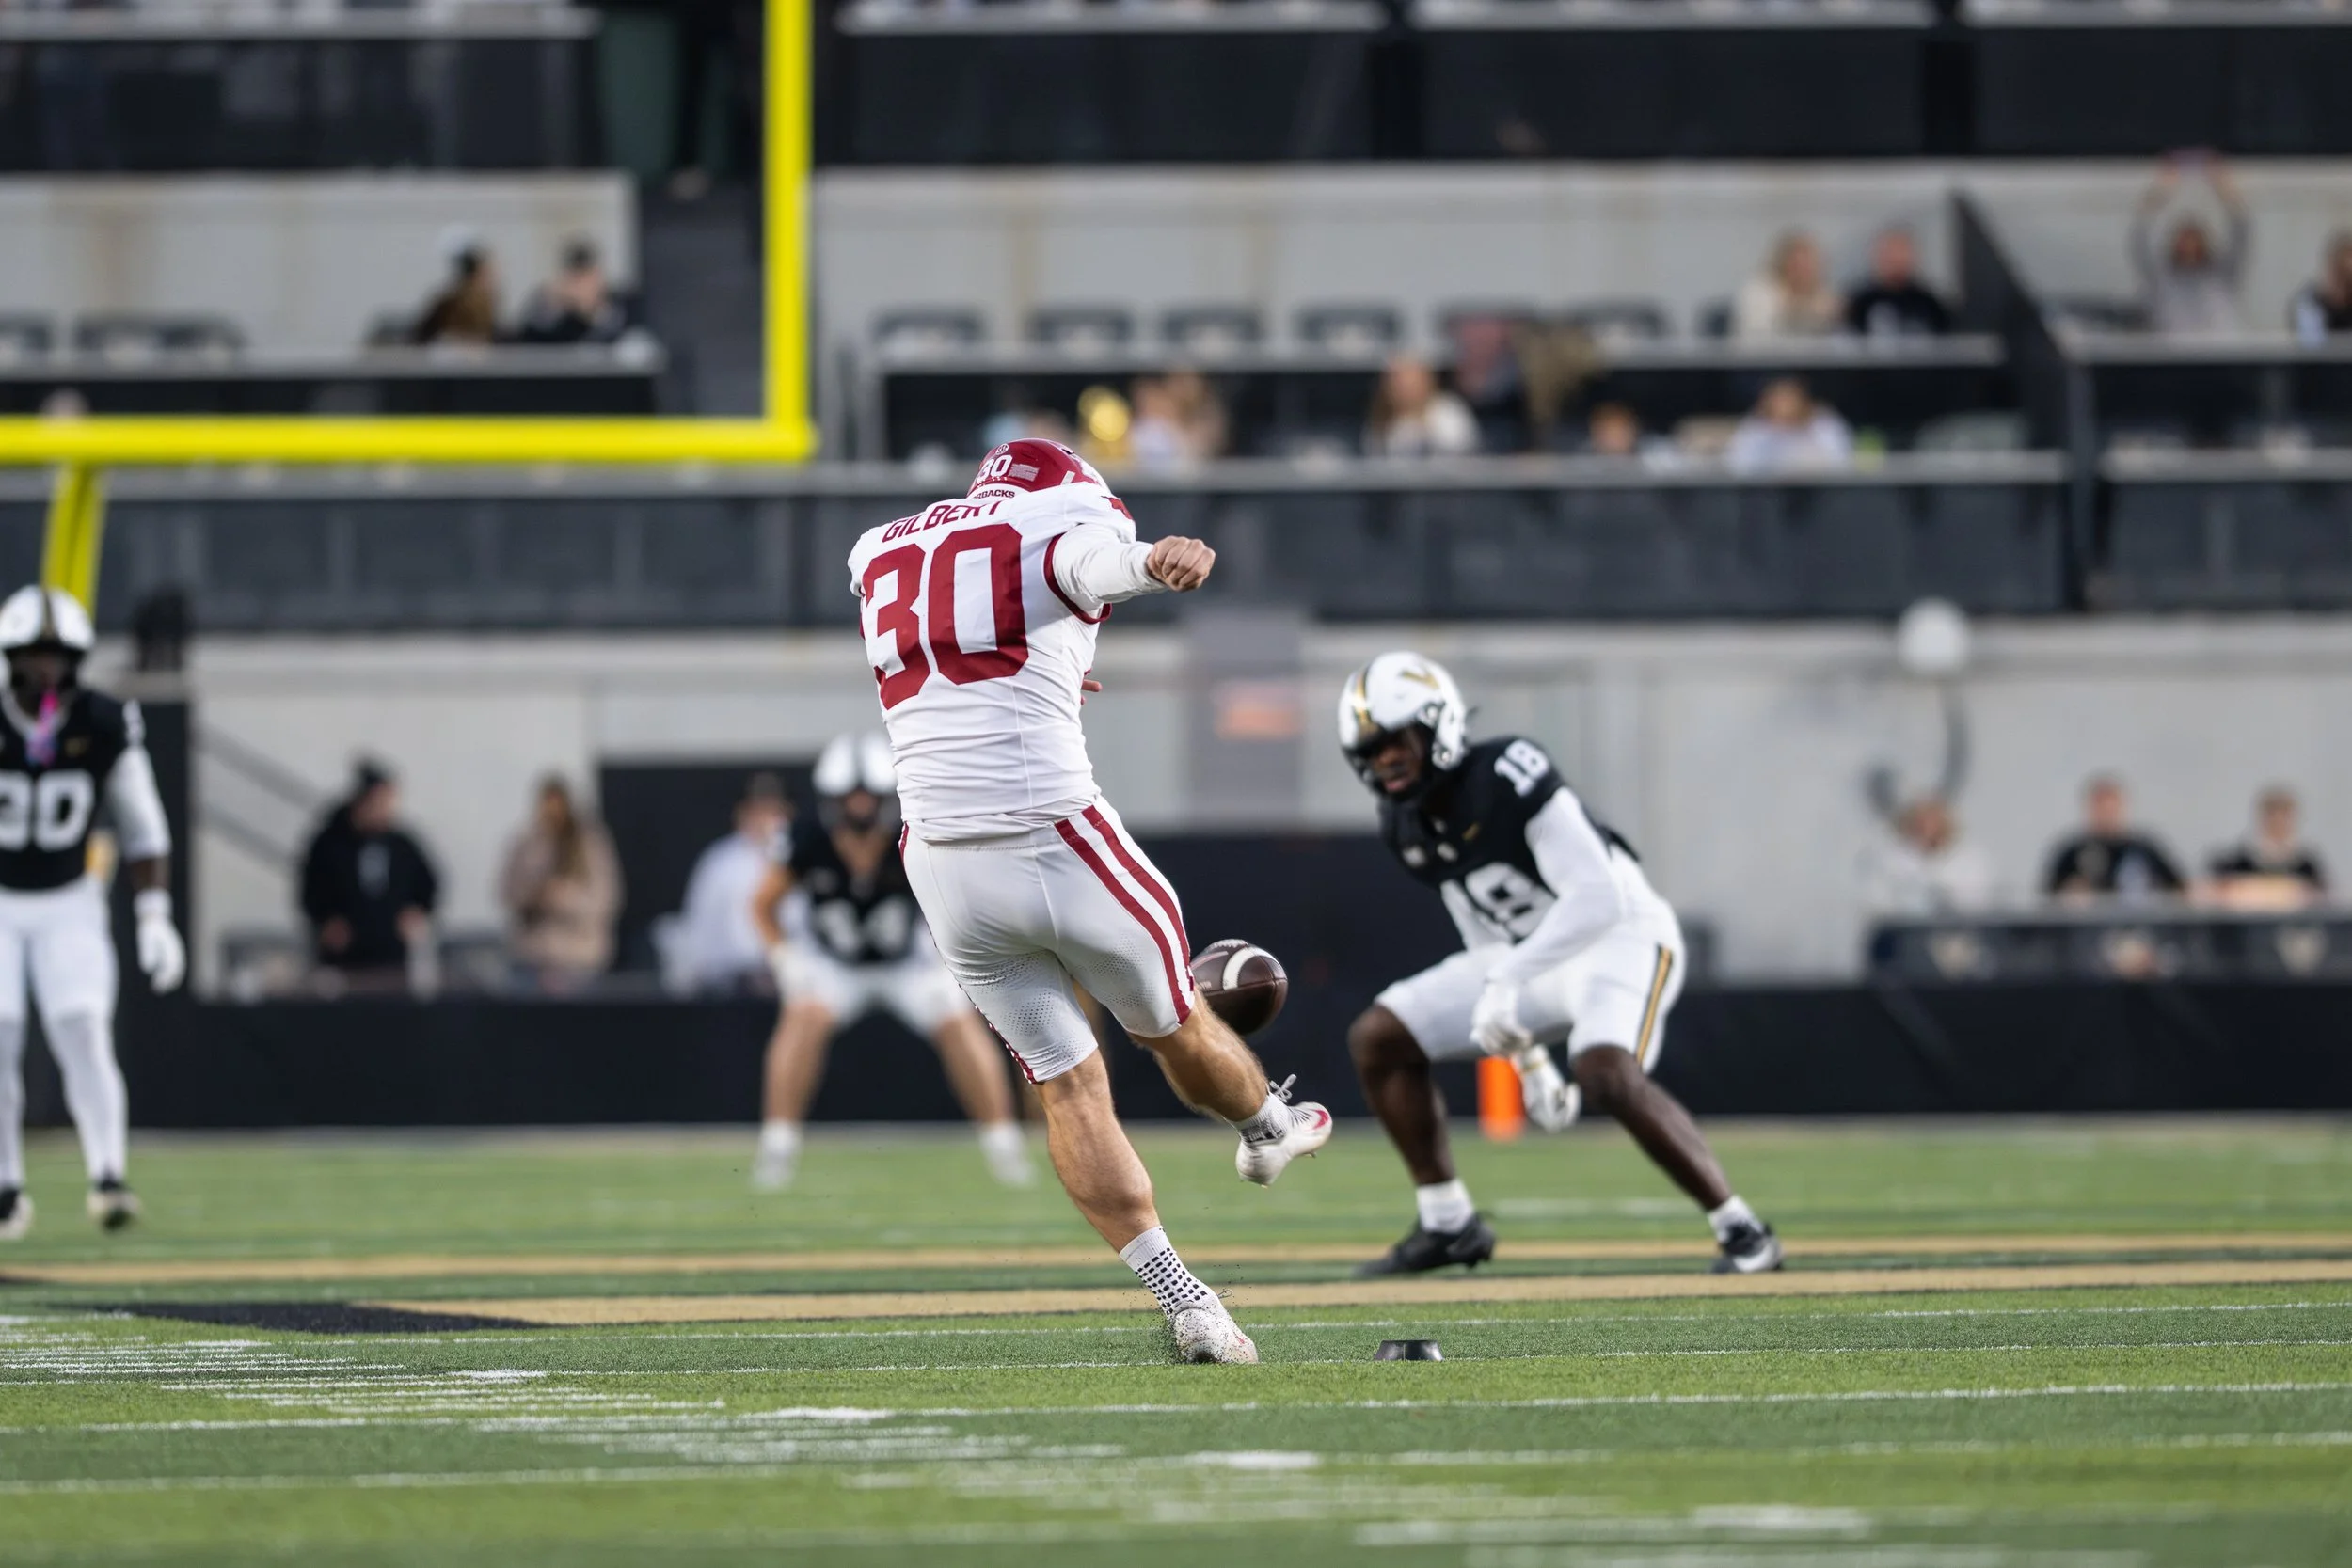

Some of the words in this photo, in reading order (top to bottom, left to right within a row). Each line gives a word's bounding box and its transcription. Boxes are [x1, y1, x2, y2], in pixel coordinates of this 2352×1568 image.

[977, 454, 1013, 483] 30
[862, 523, 1029, 710] 30
[1495, 739, 1550, 798] 18
